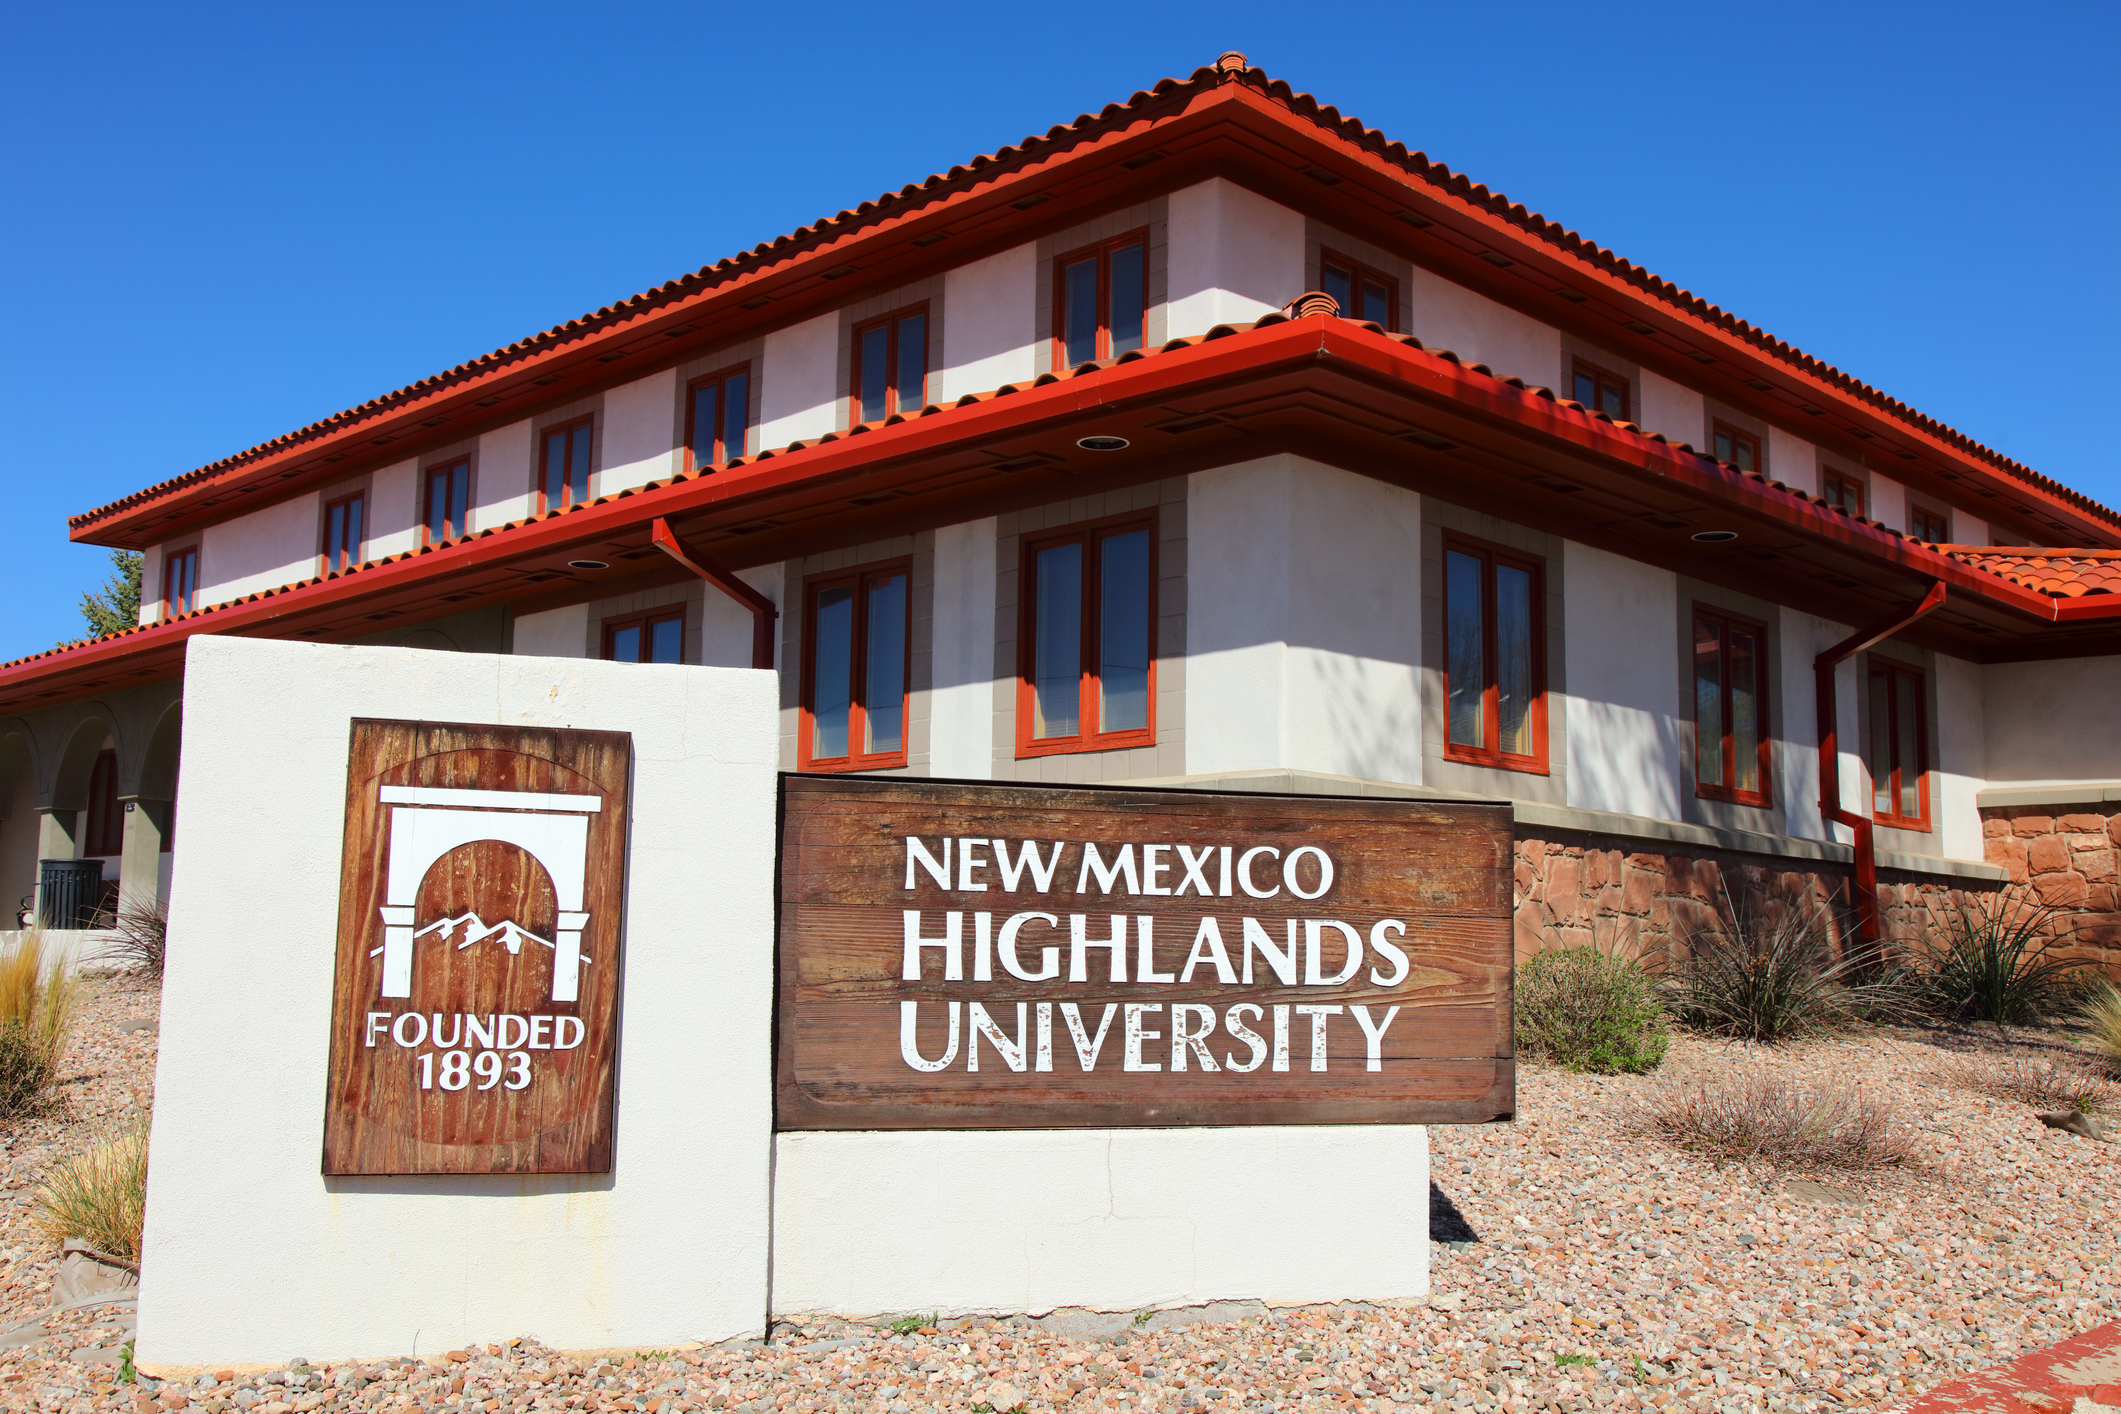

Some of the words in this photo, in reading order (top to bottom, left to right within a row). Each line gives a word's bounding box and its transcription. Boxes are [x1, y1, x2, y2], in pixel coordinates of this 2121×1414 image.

[904, 836, 1065, 894] NEW
[1075, 842, 1334, 900] MEXICO
[902, 909, 1410, 987] HIGHLANDS
[365, 1011, 585, 1051] FOUNDED
[900, 1000, 1402, 1073] UNIVERSITY
[418, 1050, 533, 1092] 1893
